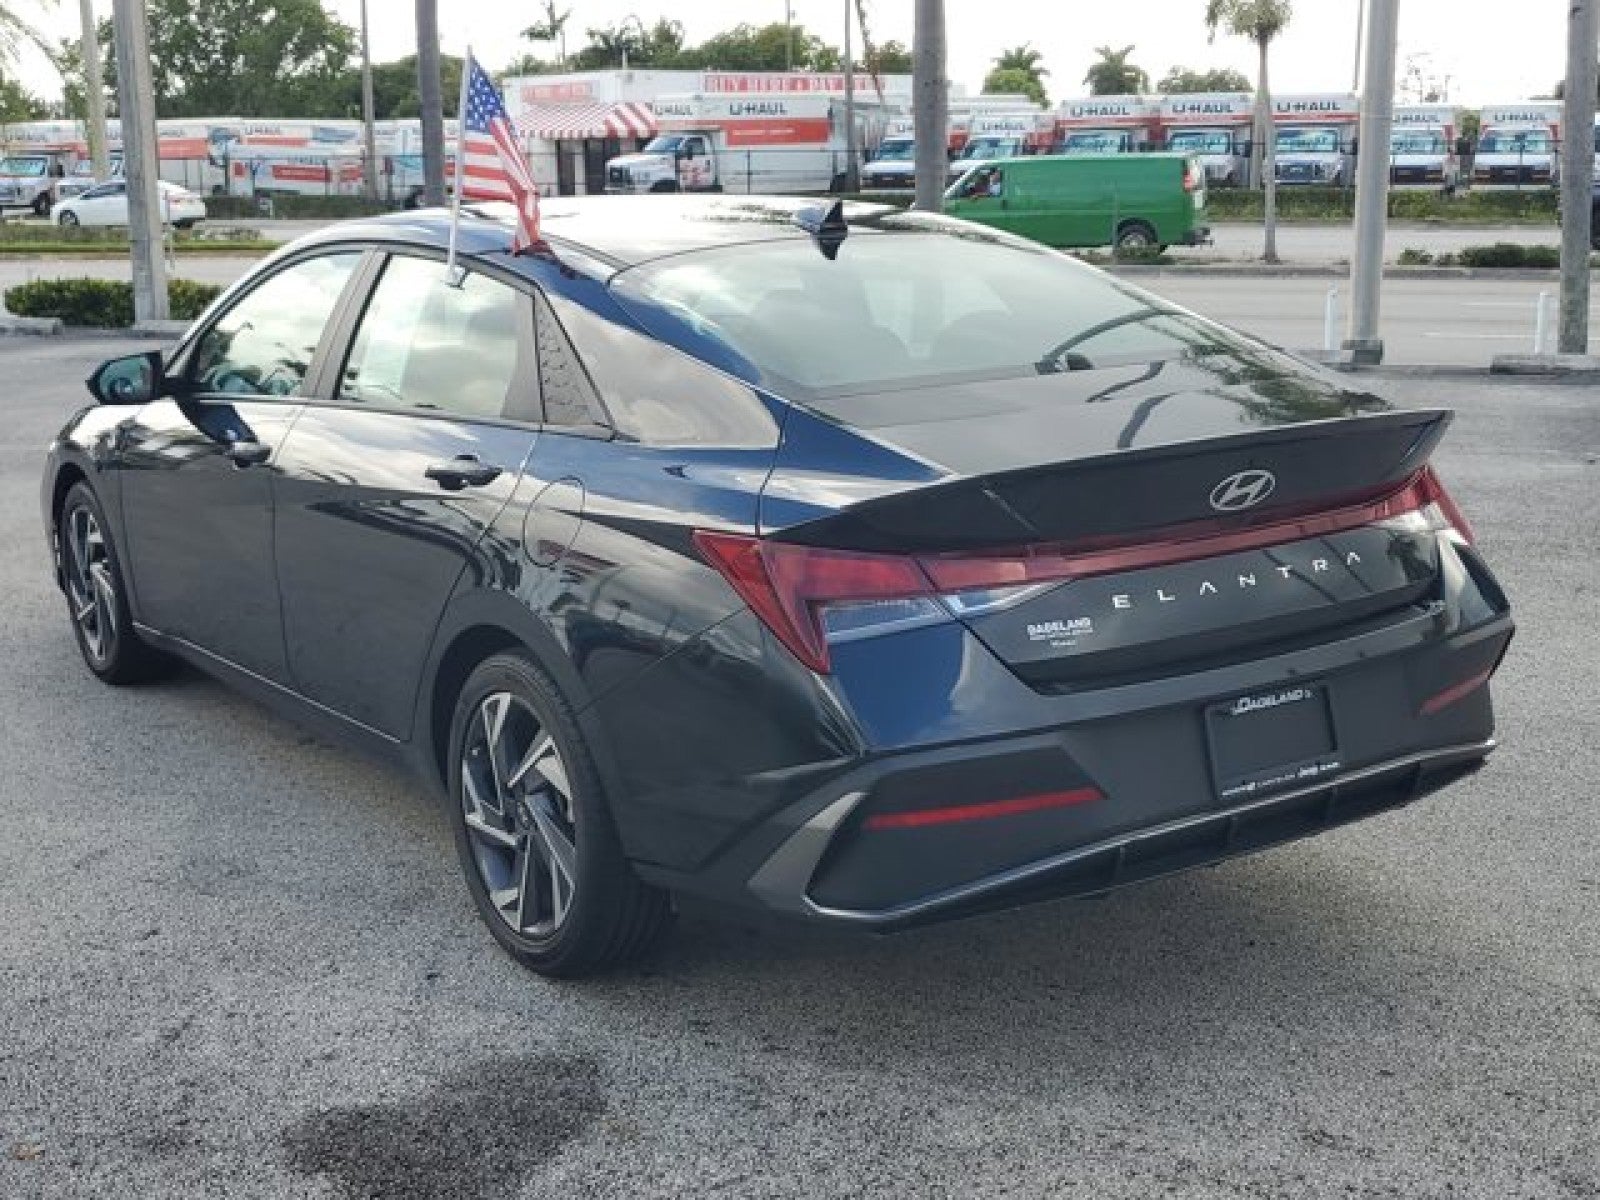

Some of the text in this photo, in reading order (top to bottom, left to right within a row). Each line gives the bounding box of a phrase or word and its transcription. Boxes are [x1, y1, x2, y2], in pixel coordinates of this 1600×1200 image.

[729, 102, 788, 115] U-HAUL
[1070, 105, 1131, 117] U-HAUL
[1172, 103, 1234, 114] U-HAUL
[1276, 101, 1341, 113] U-HAUL
[1111, 551, 1361, 609] ELANTRA
